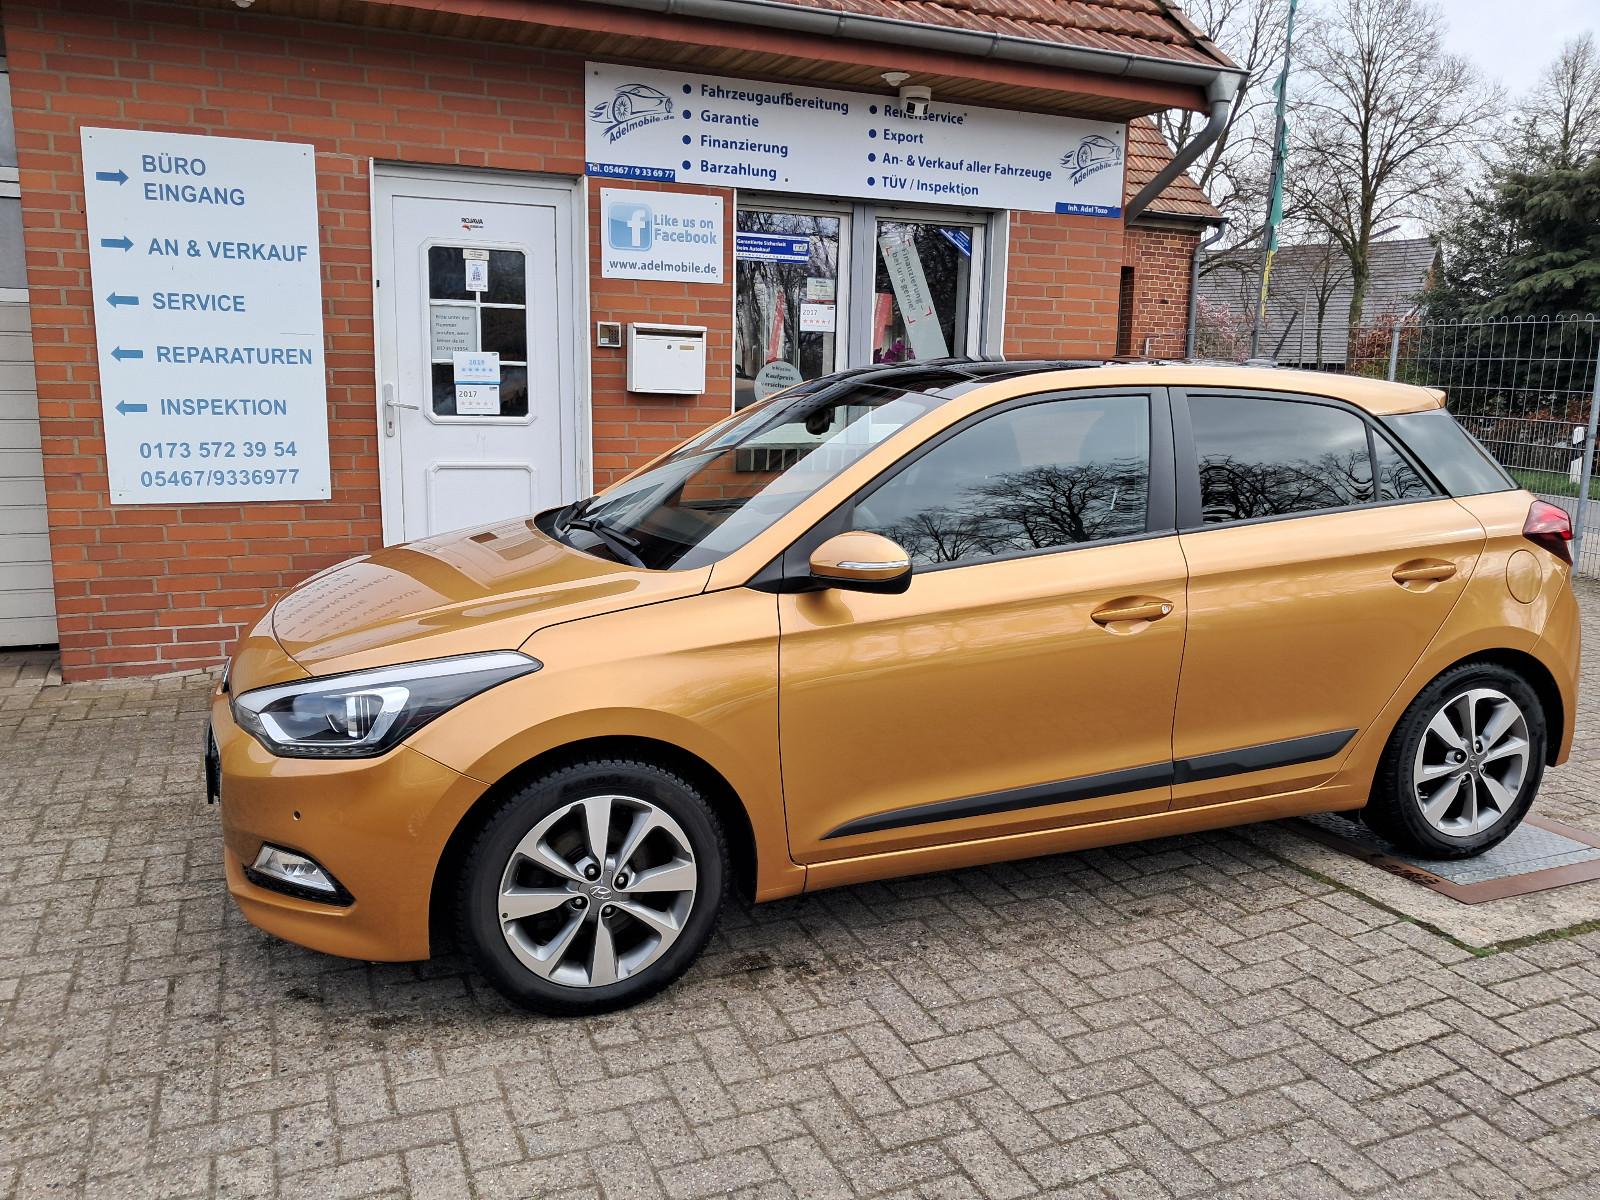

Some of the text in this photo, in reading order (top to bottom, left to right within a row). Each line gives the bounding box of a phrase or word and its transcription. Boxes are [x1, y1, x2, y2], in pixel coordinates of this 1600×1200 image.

[701, 84, 849, 115] Fahrzeugaufbereitung
[701, 109, 759, 127] Garantie
[609, 114, 675, 144] Adelmobile.de
[883, 129, 924, 144] Export
[701, 134, 788, 157] Finanzierung
[141, 152, 206, 177] BÜRO
[588, 163, 602, 174] Tel.
[603, 164, 629, 176] 05467
[635, 167, 640, 176] 9
[641, 168, 651, 177] 33
[652, 169, 663, 178] 69
[664, 170, 675, 178] 77
[701, 160, 777, 181] Barzahlung
[882, 152, 1052, 181] An- & Verkauf aller Fahrzeuge
[143, 183, 245, 206] EINGANG
[882, 174, 907, 190] TÜV
[916, 180, 979, 197] Inspektion
[1067, 204, 1079, 212] Inh.
[1080, 205, 1094, 213] Adel
[653, 214, 714, 229] Like us on
[653, 227, 717, 245] Facebook
[147, 238, 308, 262] AN & VERKAUF
[609, 259, 717, 275] www.adelmobile.de
[152, 292, 246, 313] SERVICE
[156, 345, 312, 365] REPARATUREN
[458, 390, 478, 398] 2017
[160, 399, 287, 416] INSPEKTION
[139, 440, 297, 459] 0173 572 39 54
[140, 468, 300, 488] 05467/9336977
